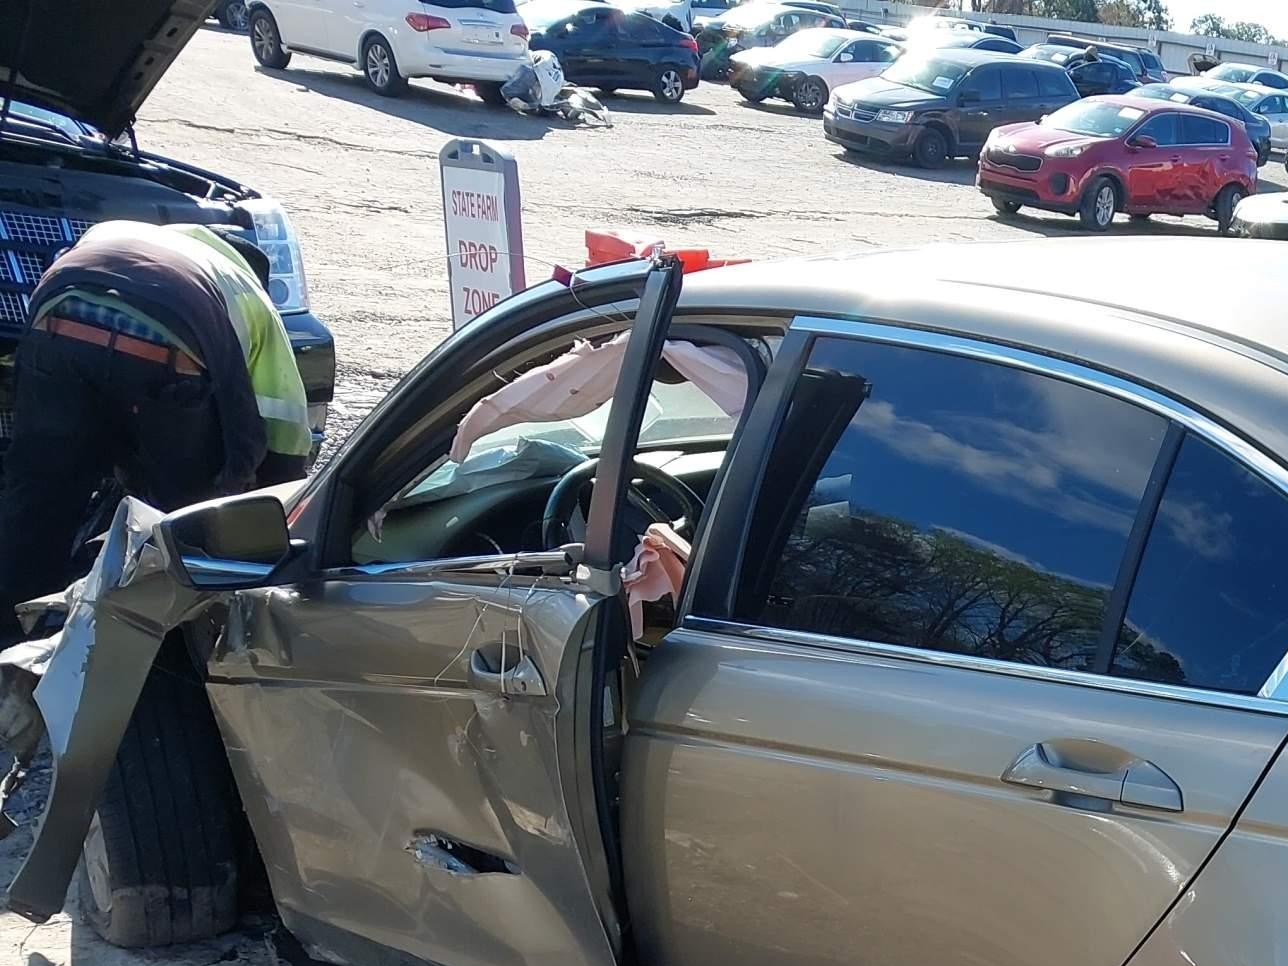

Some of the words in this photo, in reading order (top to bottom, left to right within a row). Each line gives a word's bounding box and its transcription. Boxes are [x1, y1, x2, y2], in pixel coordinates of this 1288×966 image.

[452, 190, 475, 218] STATE
[477, 193, 498, 222] FARM
[459, 240, 498, 273] DROP
